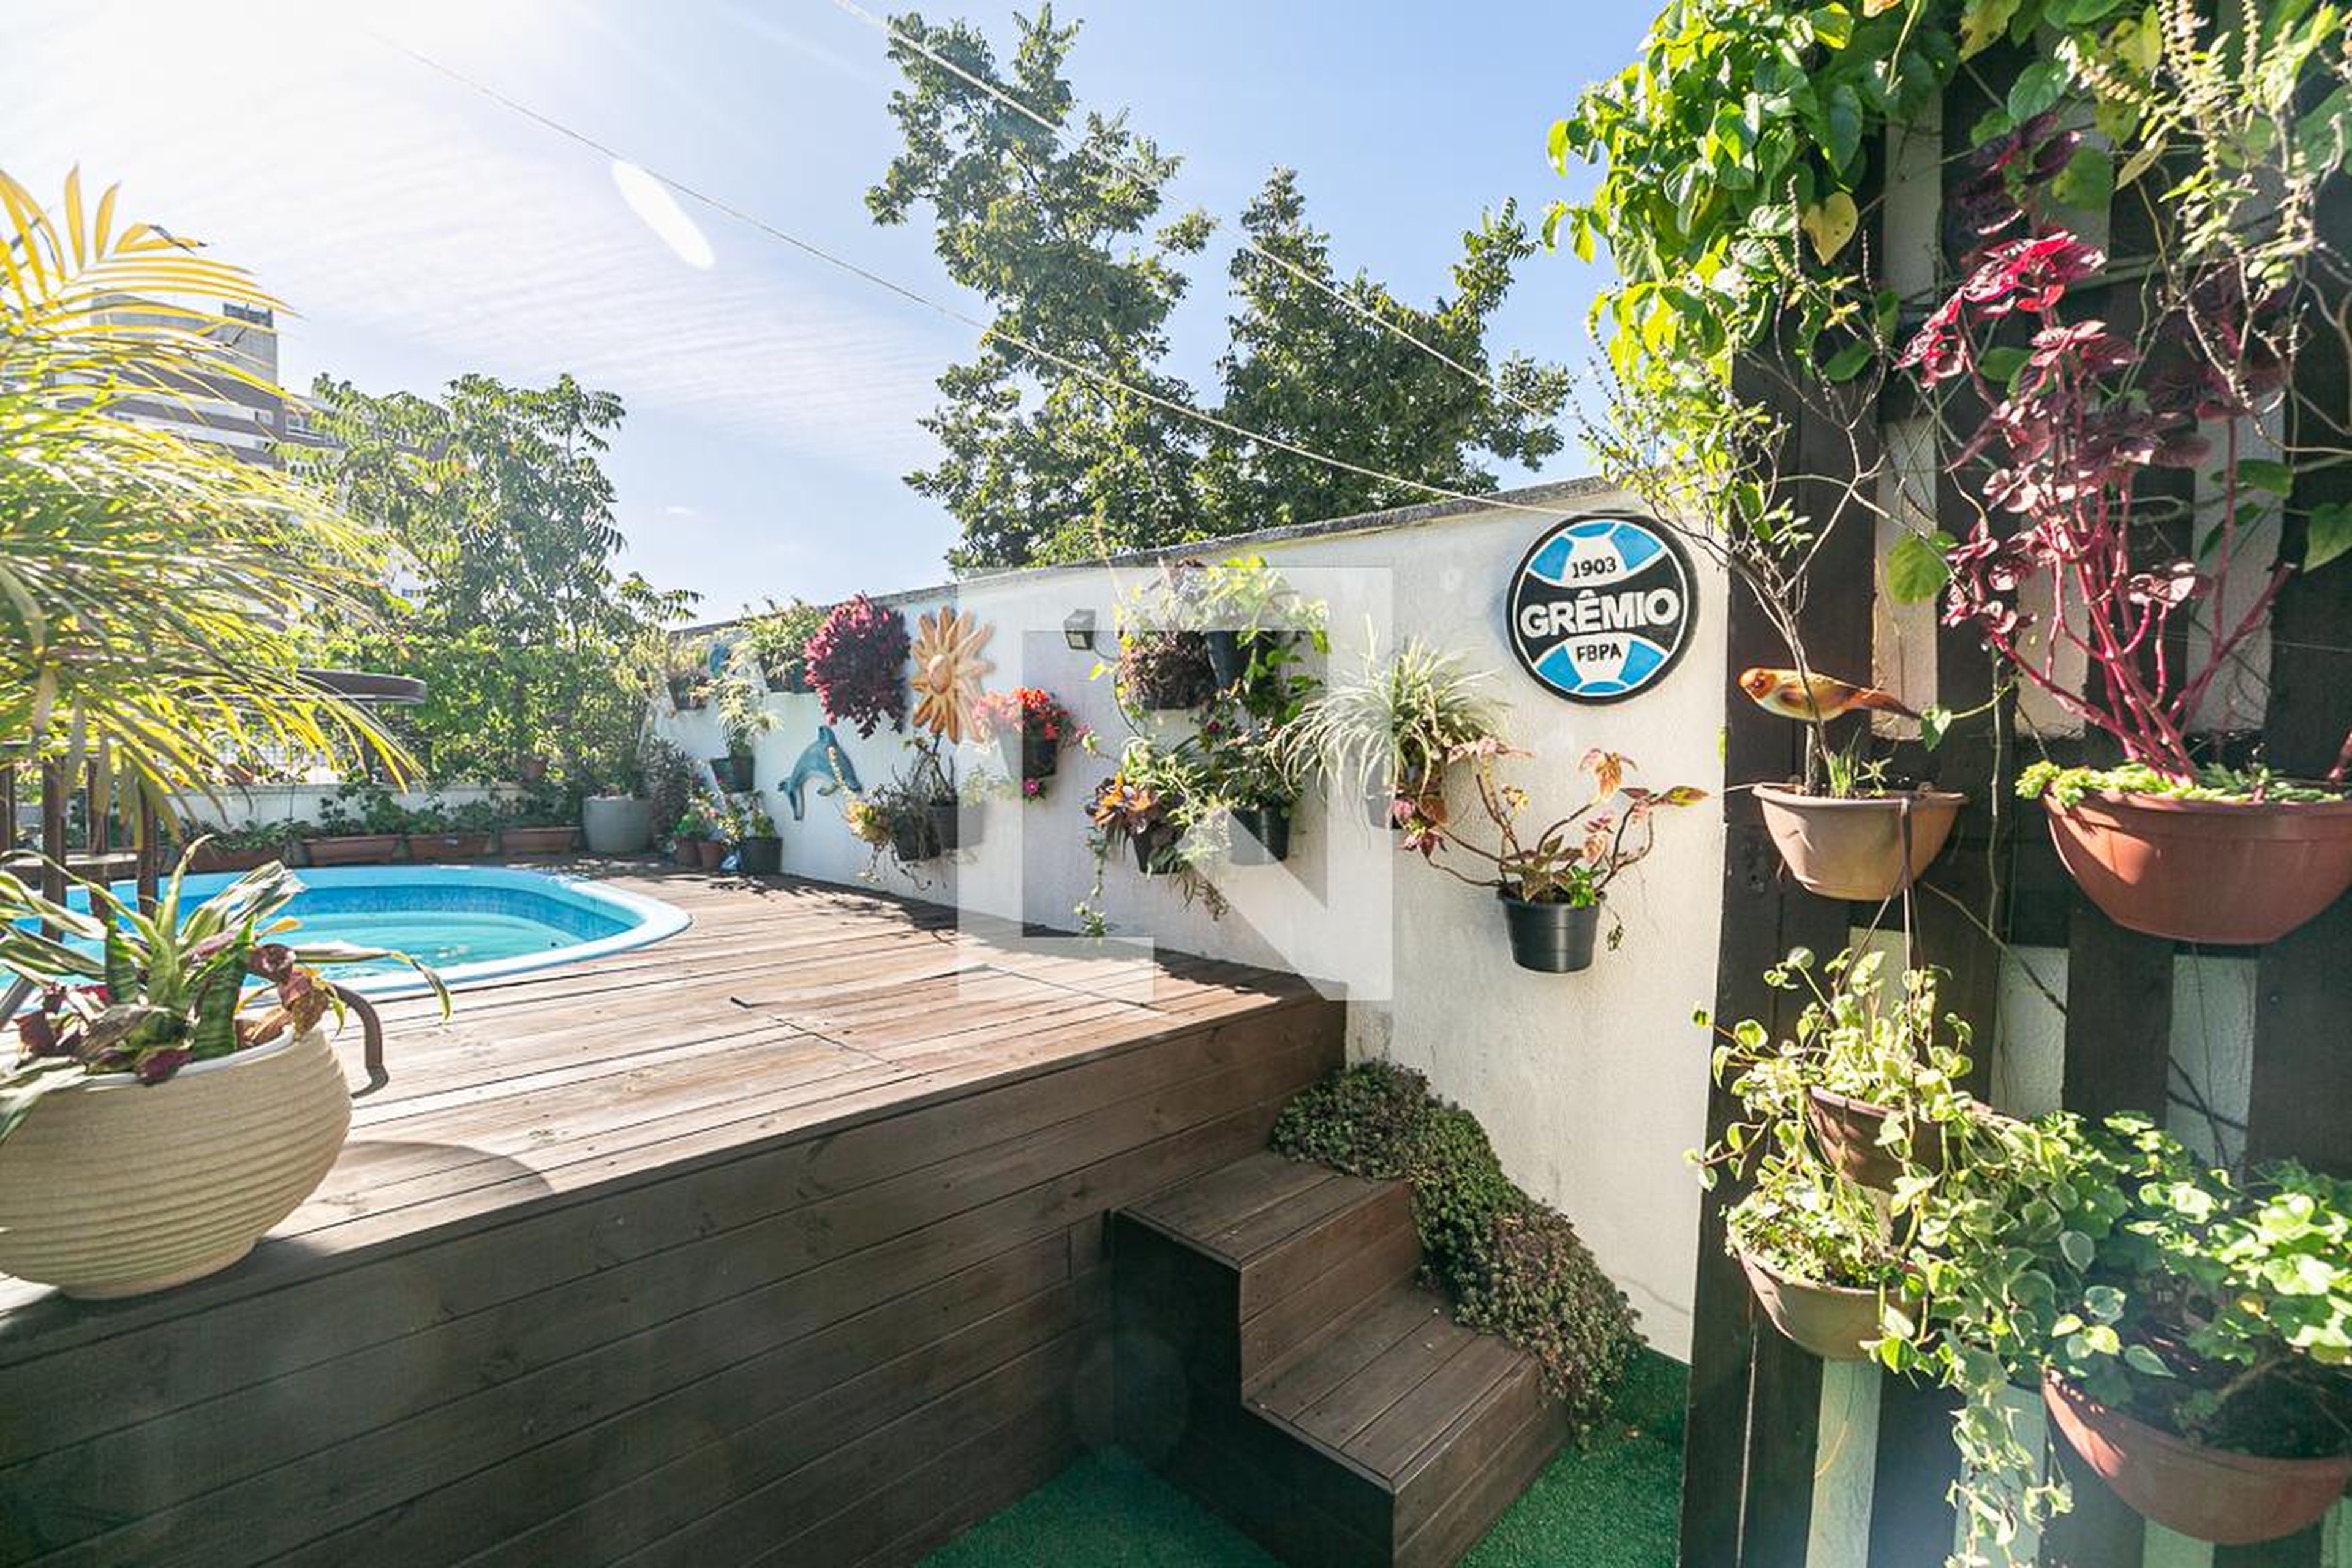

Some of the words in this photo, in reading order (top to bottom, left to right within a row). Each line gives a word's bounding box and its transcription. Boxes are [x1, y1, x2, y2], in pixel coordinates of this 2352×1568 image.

[1572, 557, 1617, 578] 1903
[1520, 588, 1680, 638] GRÊMIO
[1576, 643, 1622, 662] FBPA
